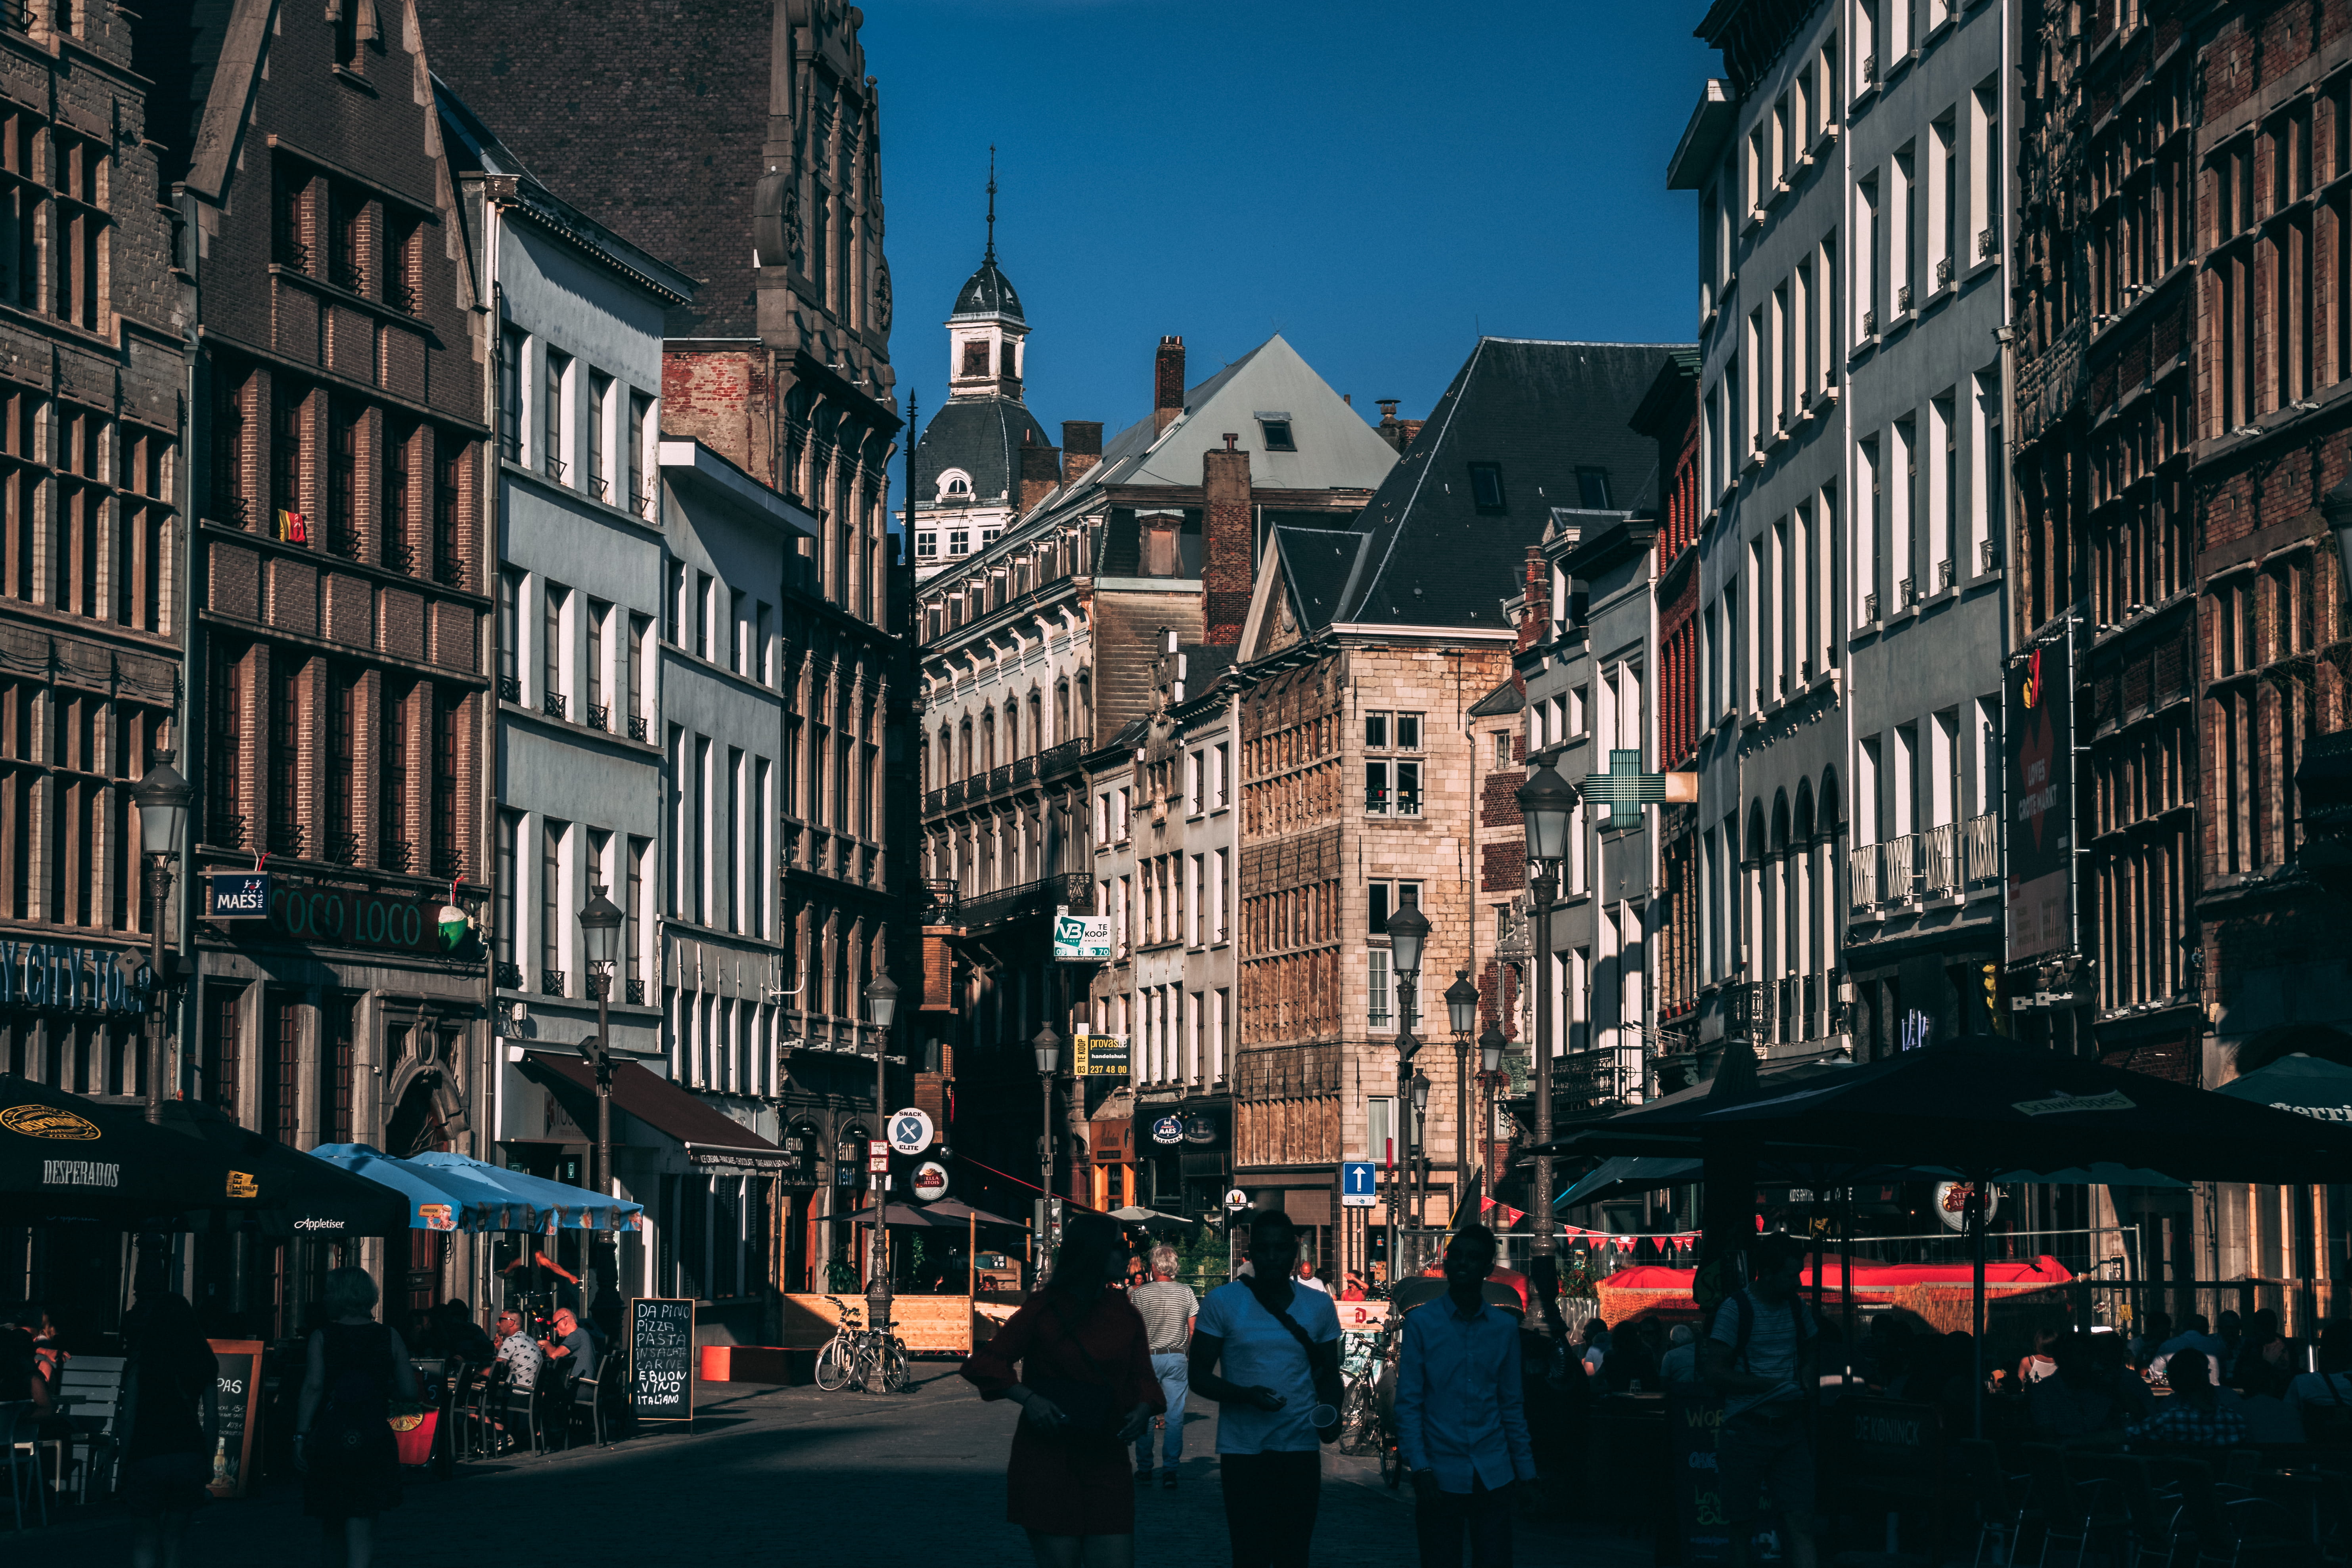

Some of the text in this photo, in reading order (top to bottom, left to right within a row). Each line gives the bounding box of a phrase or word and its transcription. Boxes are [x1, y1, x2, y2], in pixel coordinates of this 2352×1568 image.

[2028, 758, 2045, 787] LOVES
[2019, 783, 2057, 821] GROTE MARKT
[217, 894, 256, 908] MAES
[272, 889, 421, 945] COCO LOCO
[1059, 923, 1082, 938] VB
[25, 944, 84, 1007] CITY
[2020, 1096, 2127, 1112] Schweppes
[706, 1154, 720, 1163] CREAM
[43, 1160, 119, 1187] DESPERADOS
[233, 1174, 243, 1195] BEER
[294, 1218, 345, 1230] Appletiser
[639, 1304, 656, 1317] DA
[637, 1333, 686, 1347] PASTA
[637, 1359, 684, 1370] CARNE
[639, 1370, 687, 1382] E BUON
[1855, 1415, 1920, 1447] DE KONINCK
